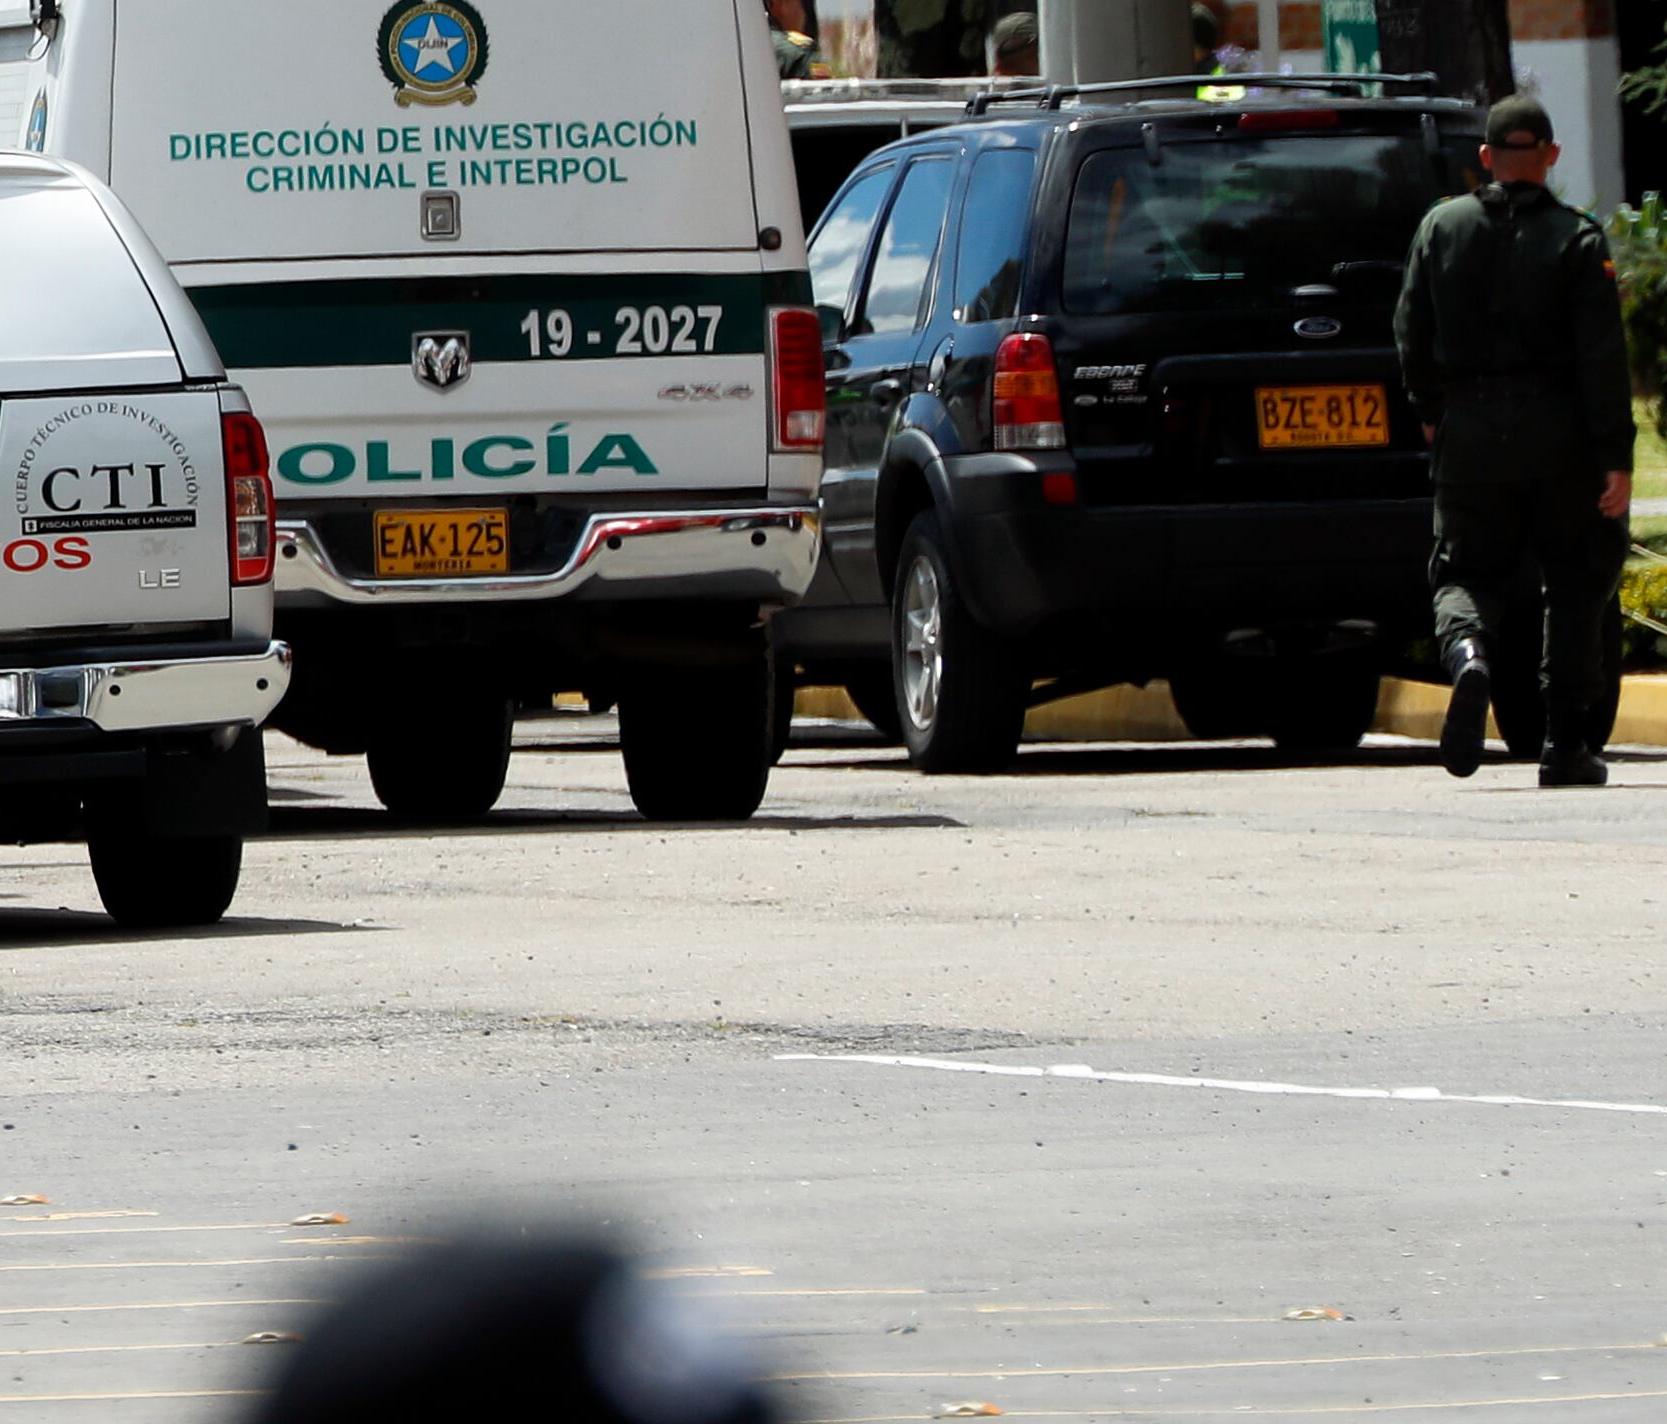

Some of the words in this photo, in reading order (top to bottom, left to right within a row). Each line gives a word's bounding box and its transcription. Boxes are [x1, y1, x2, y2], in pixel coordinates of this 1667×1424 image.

[169, 122, 364, 161] DIRECCIÓN
[377, 126, 421, 153] DE
[434, 113, 697, 152] INVESTIGACIÓN
[246, 162, 416, 193] CRIMINAL
[427, 161, 448, 188] E
[460, 156, 628, 186] INTERPOL
[521, 308, 573, 357] 19
[587, 330, 602, 344] -
[616, 305, 724, 354] 2027
[16, 448, 36, 515] CUERPO
[97, 401, 119, 414] DE
[122, 404, 201, 507] INVESTIGACIÓN
[276, 421, 659, 486] OLICÍA
[41, 462, 168, 513] CTI
[82, 518, 126, 527] GENERAL
[127, 517, 141, 525] DE
[138, 568, 181, 589] LE
